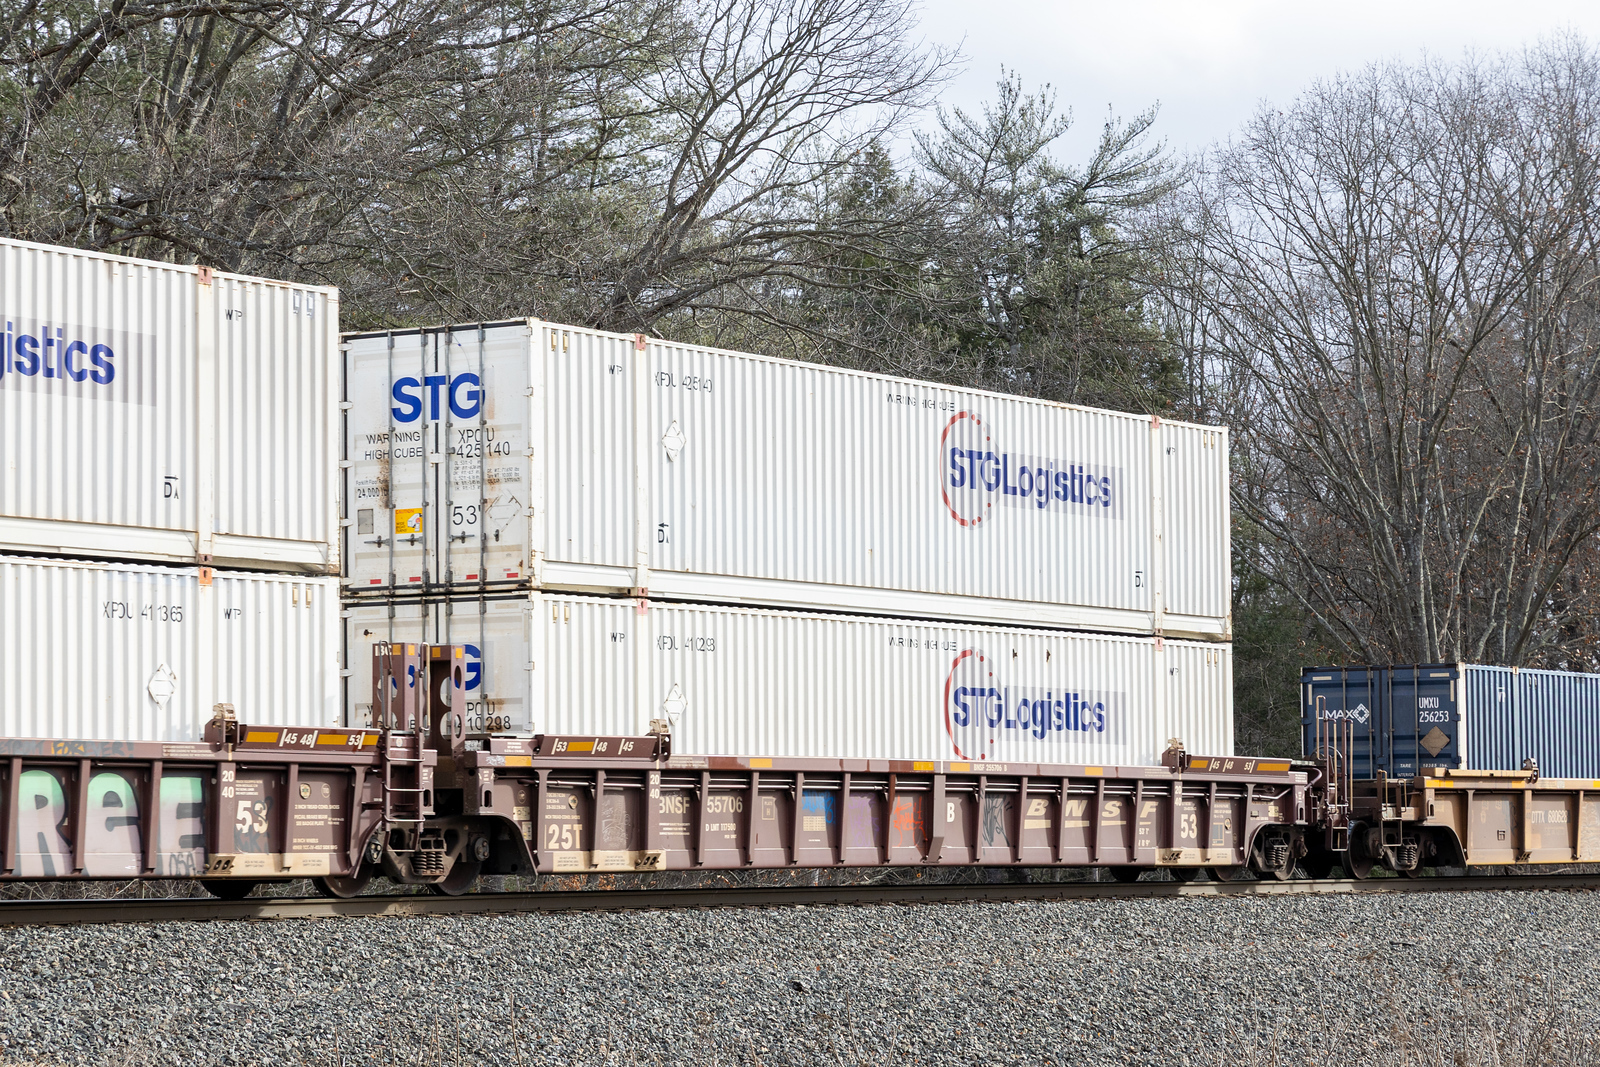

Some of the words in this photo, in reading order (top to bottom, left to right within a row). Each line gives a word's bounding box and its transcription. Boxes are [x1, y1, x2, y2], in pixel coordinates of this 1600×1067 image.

[0, 320, 115, 385] istics
[391, 372, 485, 423] STG
[366, 431, 421, 444] WARNING
[365, 450, 390, 460] HIGH
[394, 447, 423, 459] CUBE
[456, 441, 511, 458] 425140
[141, 604, 183, 623] 411365
[467, 702, 496, 715] POU
[1418, 697, 1439, 709] UMXU
[1419, 710, 1449, 723] 256253
[467, 716, 512, 731] 10298
[284, 733, 298, 745] 45
[300, 734, 312, 746] 48
[348, 734, 361, 746] 53
[555, 741, 568, 752] 53
[596, 742, 608, 753] 48
[622, 741, 634, 752] 45
[1212, 761, 1220, 770] 45
[1226, 761, 1234, 770] 48
[1244, 762, 1251, 771] 53
[222, 770, 234, 782] 20
[650, 774, 660, 785] 20
[221, 786, 235, 798] 40
[649, 788, 660, 799] 40
[1174, 785, 1182, 795] 20
[1174, 797, 1182, 807] 40
[235, 801, 269, 834] 53
[946, 802, 955, 823] B
[1180, 813, 1197, 839] 53
